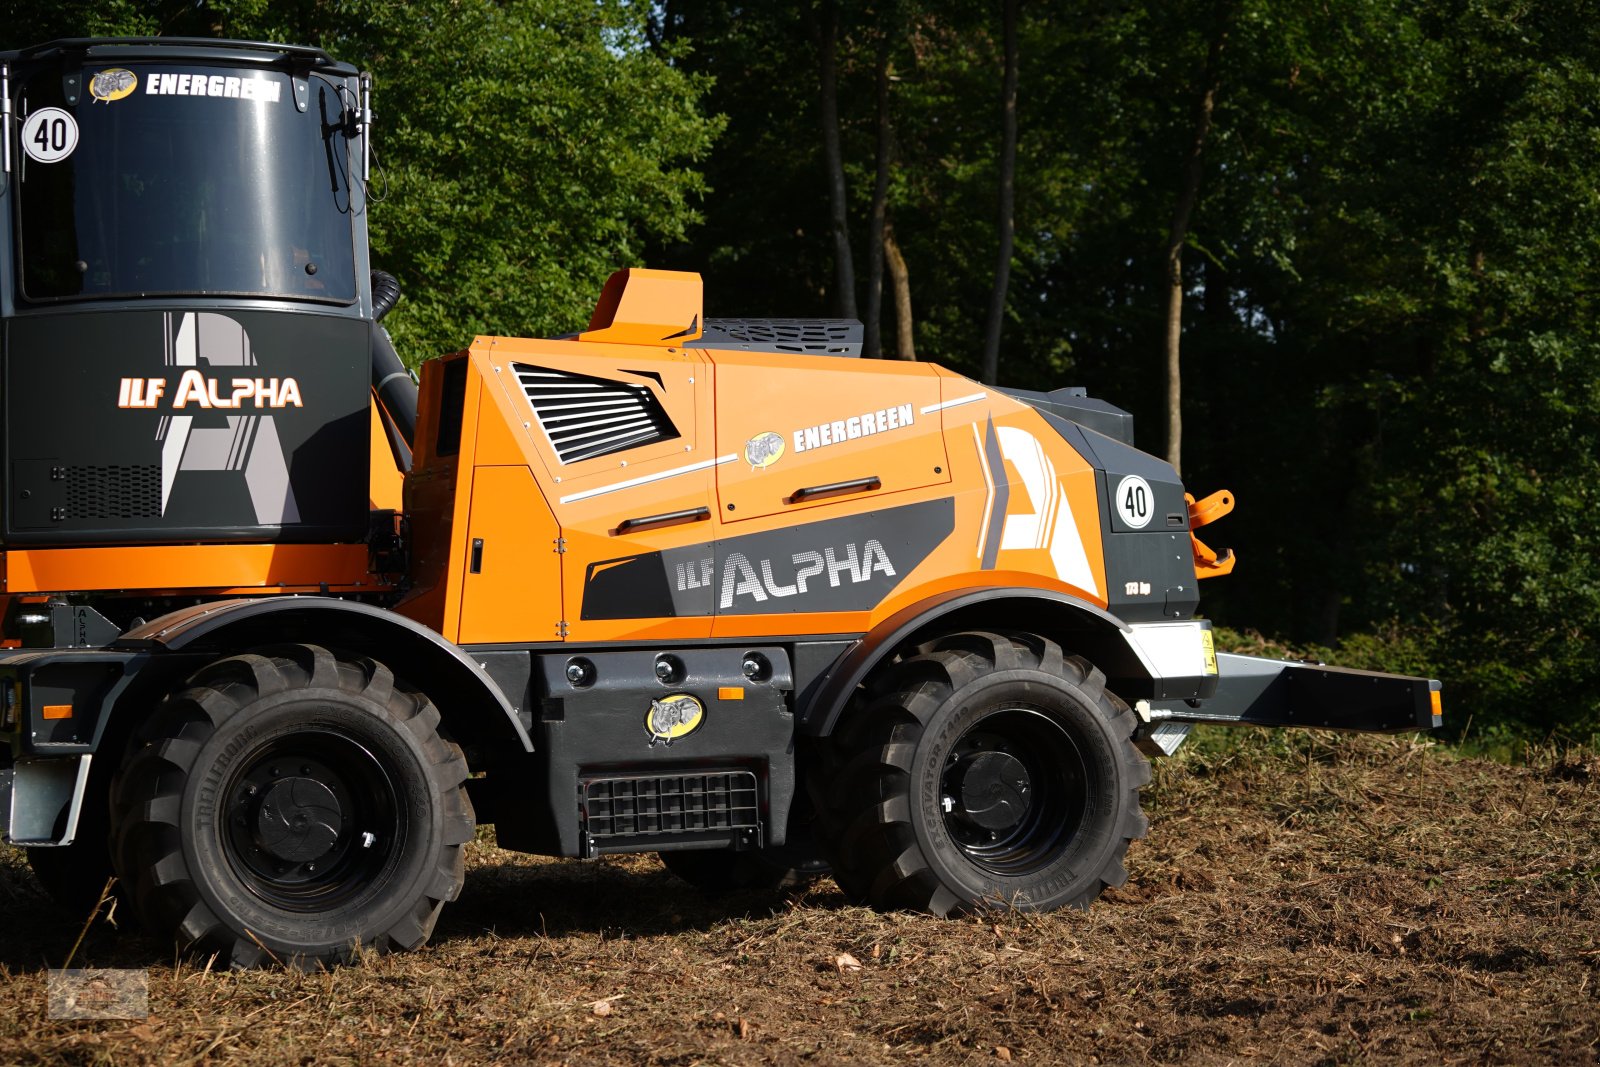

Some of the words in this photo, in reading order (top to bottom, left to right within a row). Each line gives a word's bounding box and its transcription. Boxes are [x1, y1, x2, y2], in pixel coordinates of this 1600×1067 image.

[145, 73, 281, 102] ENERGREN
[34, 118, 67, 152] 40
[118, 377, 166, 408] ILF
[172, 369, 303, 408] ALPHA
[793, 403, 914, 453] ENERGREEN
[1125, 486, 1147, 518] 40
[677, 557, 714, 591] ILF
[719, 539, 897, 609] ALPHA
